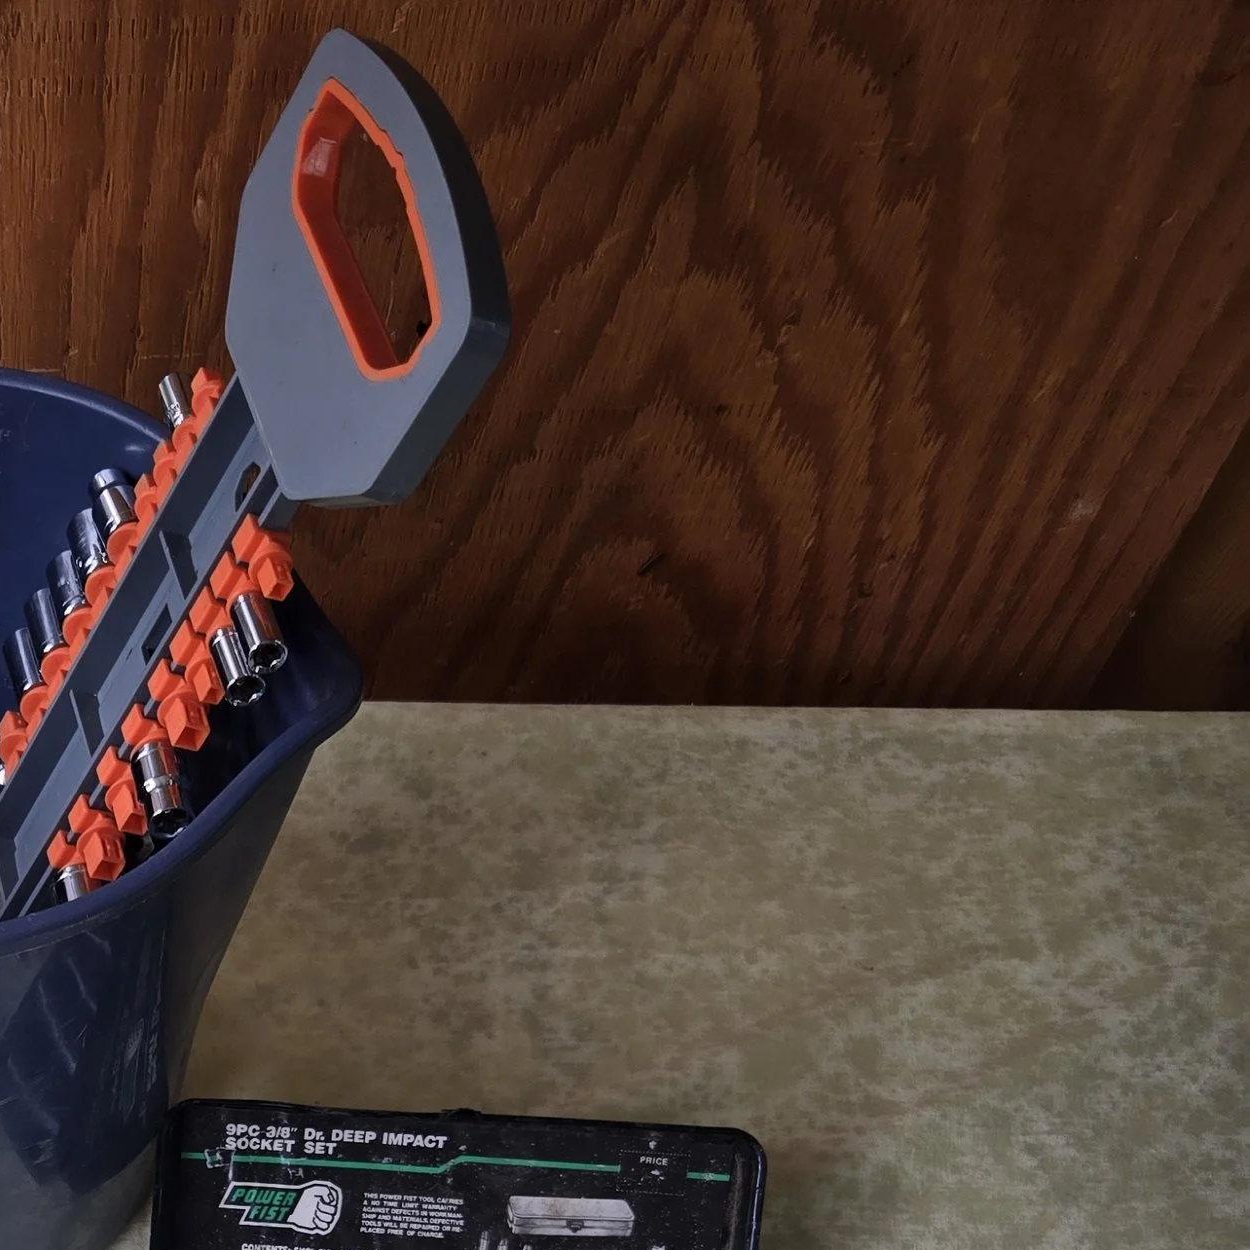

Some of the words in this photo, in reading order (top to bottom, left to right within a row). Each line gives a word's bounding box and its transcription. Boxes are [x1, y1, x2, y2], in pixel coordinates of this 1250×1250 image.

[225, 1123, 261, 1137] 9PC
[265, 1125, 298, 1139] 3/8"
[303, 1127, 325, 1141] Dr.
[331, 1129, 377, 1144] DEEP
[382, 1132, 448, 1149] IMPACT
[225, 1136, 295, 1153] SOCKET
[303, 1142, 337, 1155] SET
[639, 1155, 669, 1166] PRICE
[231, 1188, 298, 1205] POWER
[379, 1193, 402, 1201] POWER
[403, 1194, 418, 1202] FIST
[250, 1205, 290, 1222] FIST
[362, 1206, 390, 1214] AGAINST
[390, 1208, 420, 1216] DEFECTS
[409, 1223, 440, 1231] REPAIRED
[429, 1218, 464, 1226] DEFECTIVE
[360, 1227, 386, 1235] PLACED
[387, 1228, 404, 1236] FREE
